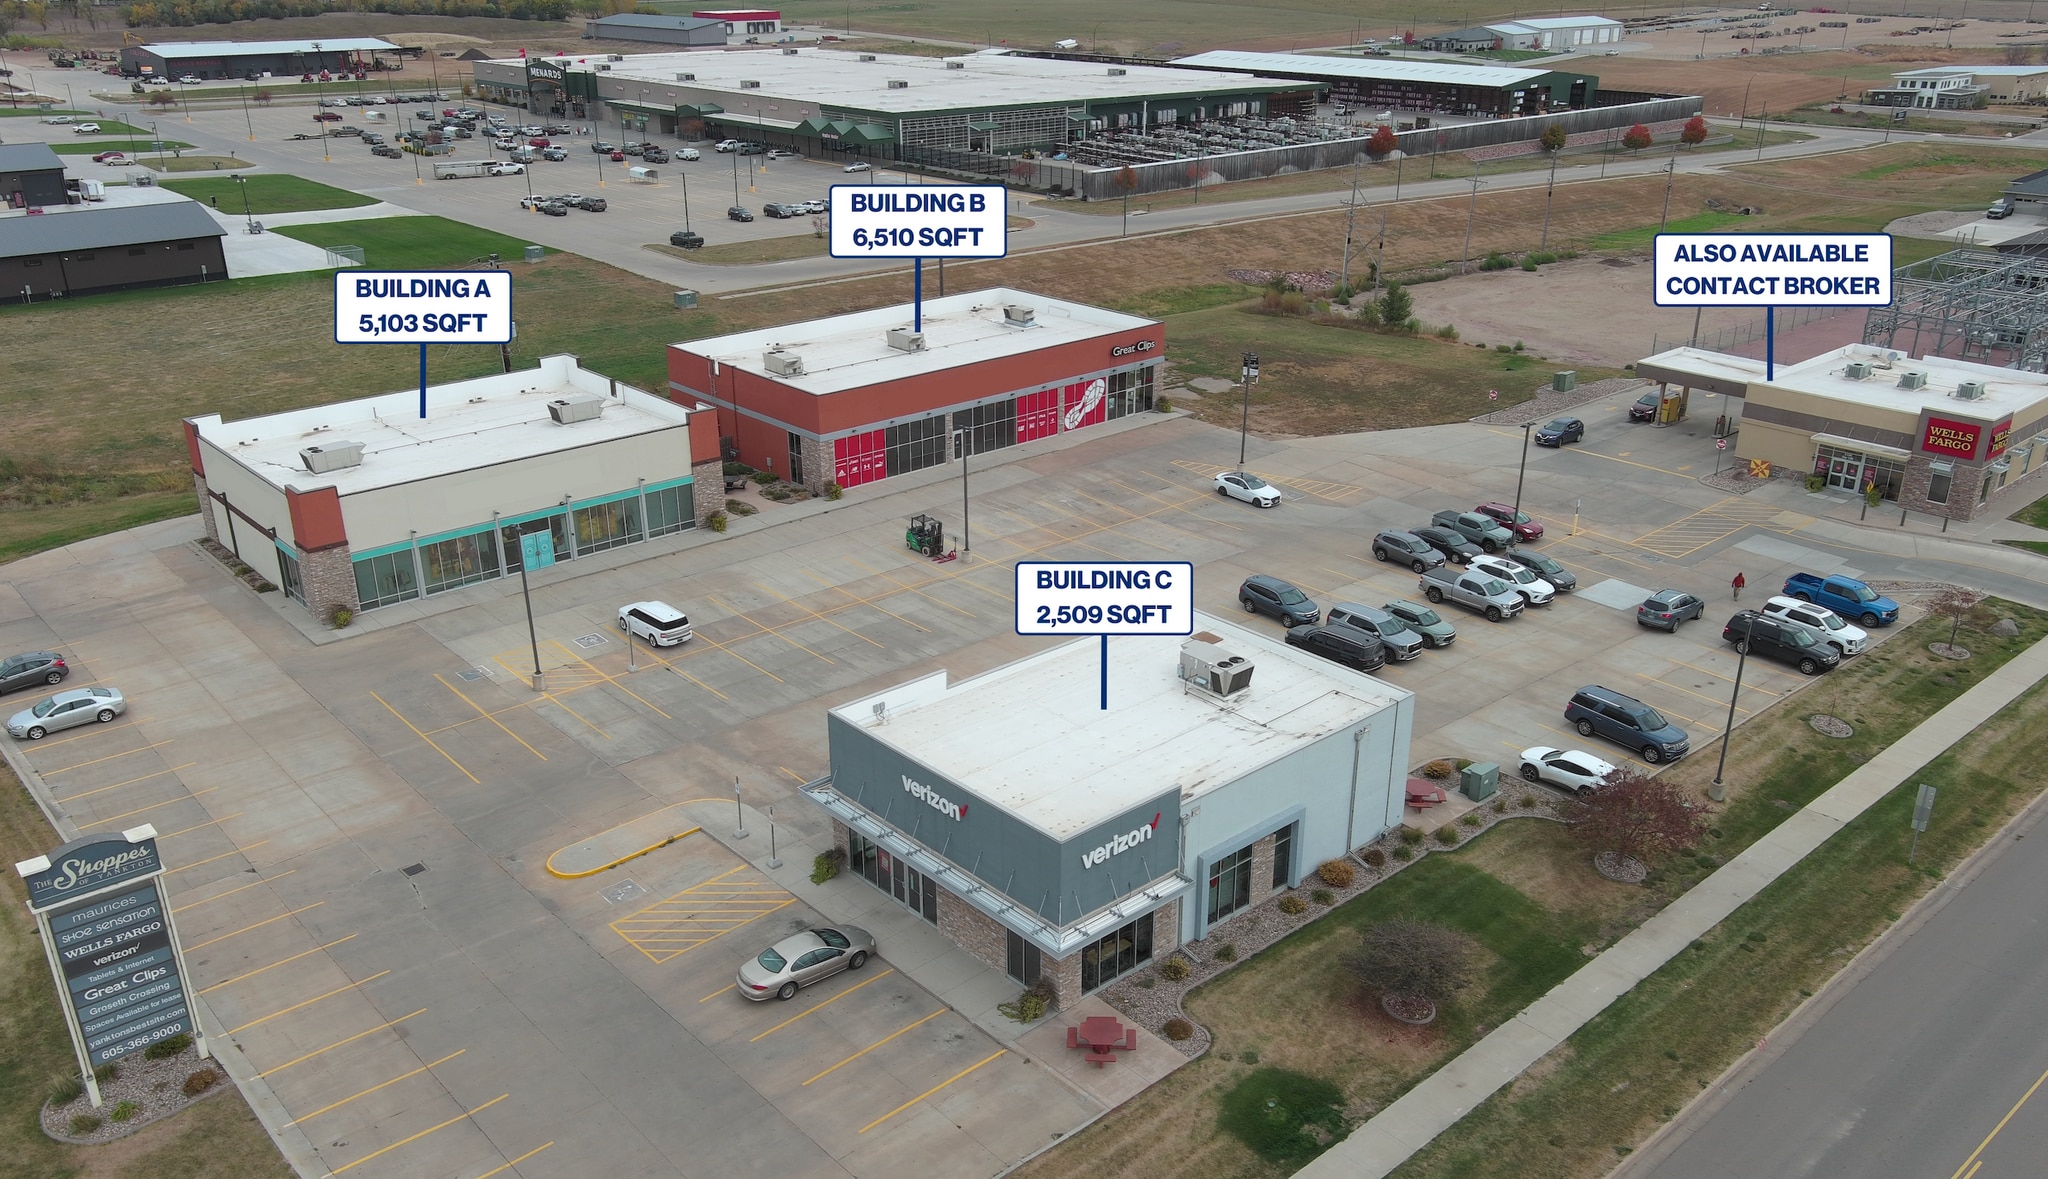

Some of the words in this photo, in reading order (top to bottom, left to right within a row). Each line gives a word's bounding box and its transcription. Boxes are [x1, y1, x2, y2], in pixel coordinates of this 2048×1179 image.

[530, 67, 562, 80] MENARDS
[1112, 345, 1136, 357] Great
[1137, 340, 1156, 352] Clips
[1928, 436, 1971, 451] FARGO
[1930, 426, 1974, 442] WELLS
[901, 774, 962, 822] verizon
[1081, 823, 1152, 870] verizon
[33, 880, 53, 889] THE
[53, 845, 151, 890] Shoppes
[78, 878, 89, 886] OF
[97, 858, 152, 880] YANKTON
[72, 896, 137, 923] maurices
[64, 937, 114, 959] WELLS
[115, 921, 161, 943] FARGO
[93, 946, 137, 967] verizon
[84, 980, 128, 1001] Great
[132, 966, 167, 983] Clips
[88, 969, 116, 983] Tablets
[125, 955, 155, 970] Internet
[85, 1018, 115, 1033] Spaces
[116, 1003, 150, 1021] Available
[150, 1000, 161, 1008] for
[161, 993, 182, 1004] lease
[89, 998, 127, 1016] Groseth
[129, 982, 171, 1001] Crossing
[90, 1007, 186, 1049] yanktonsbestsite.com
[102, 1023, 182, 1060] 605-366-9000
